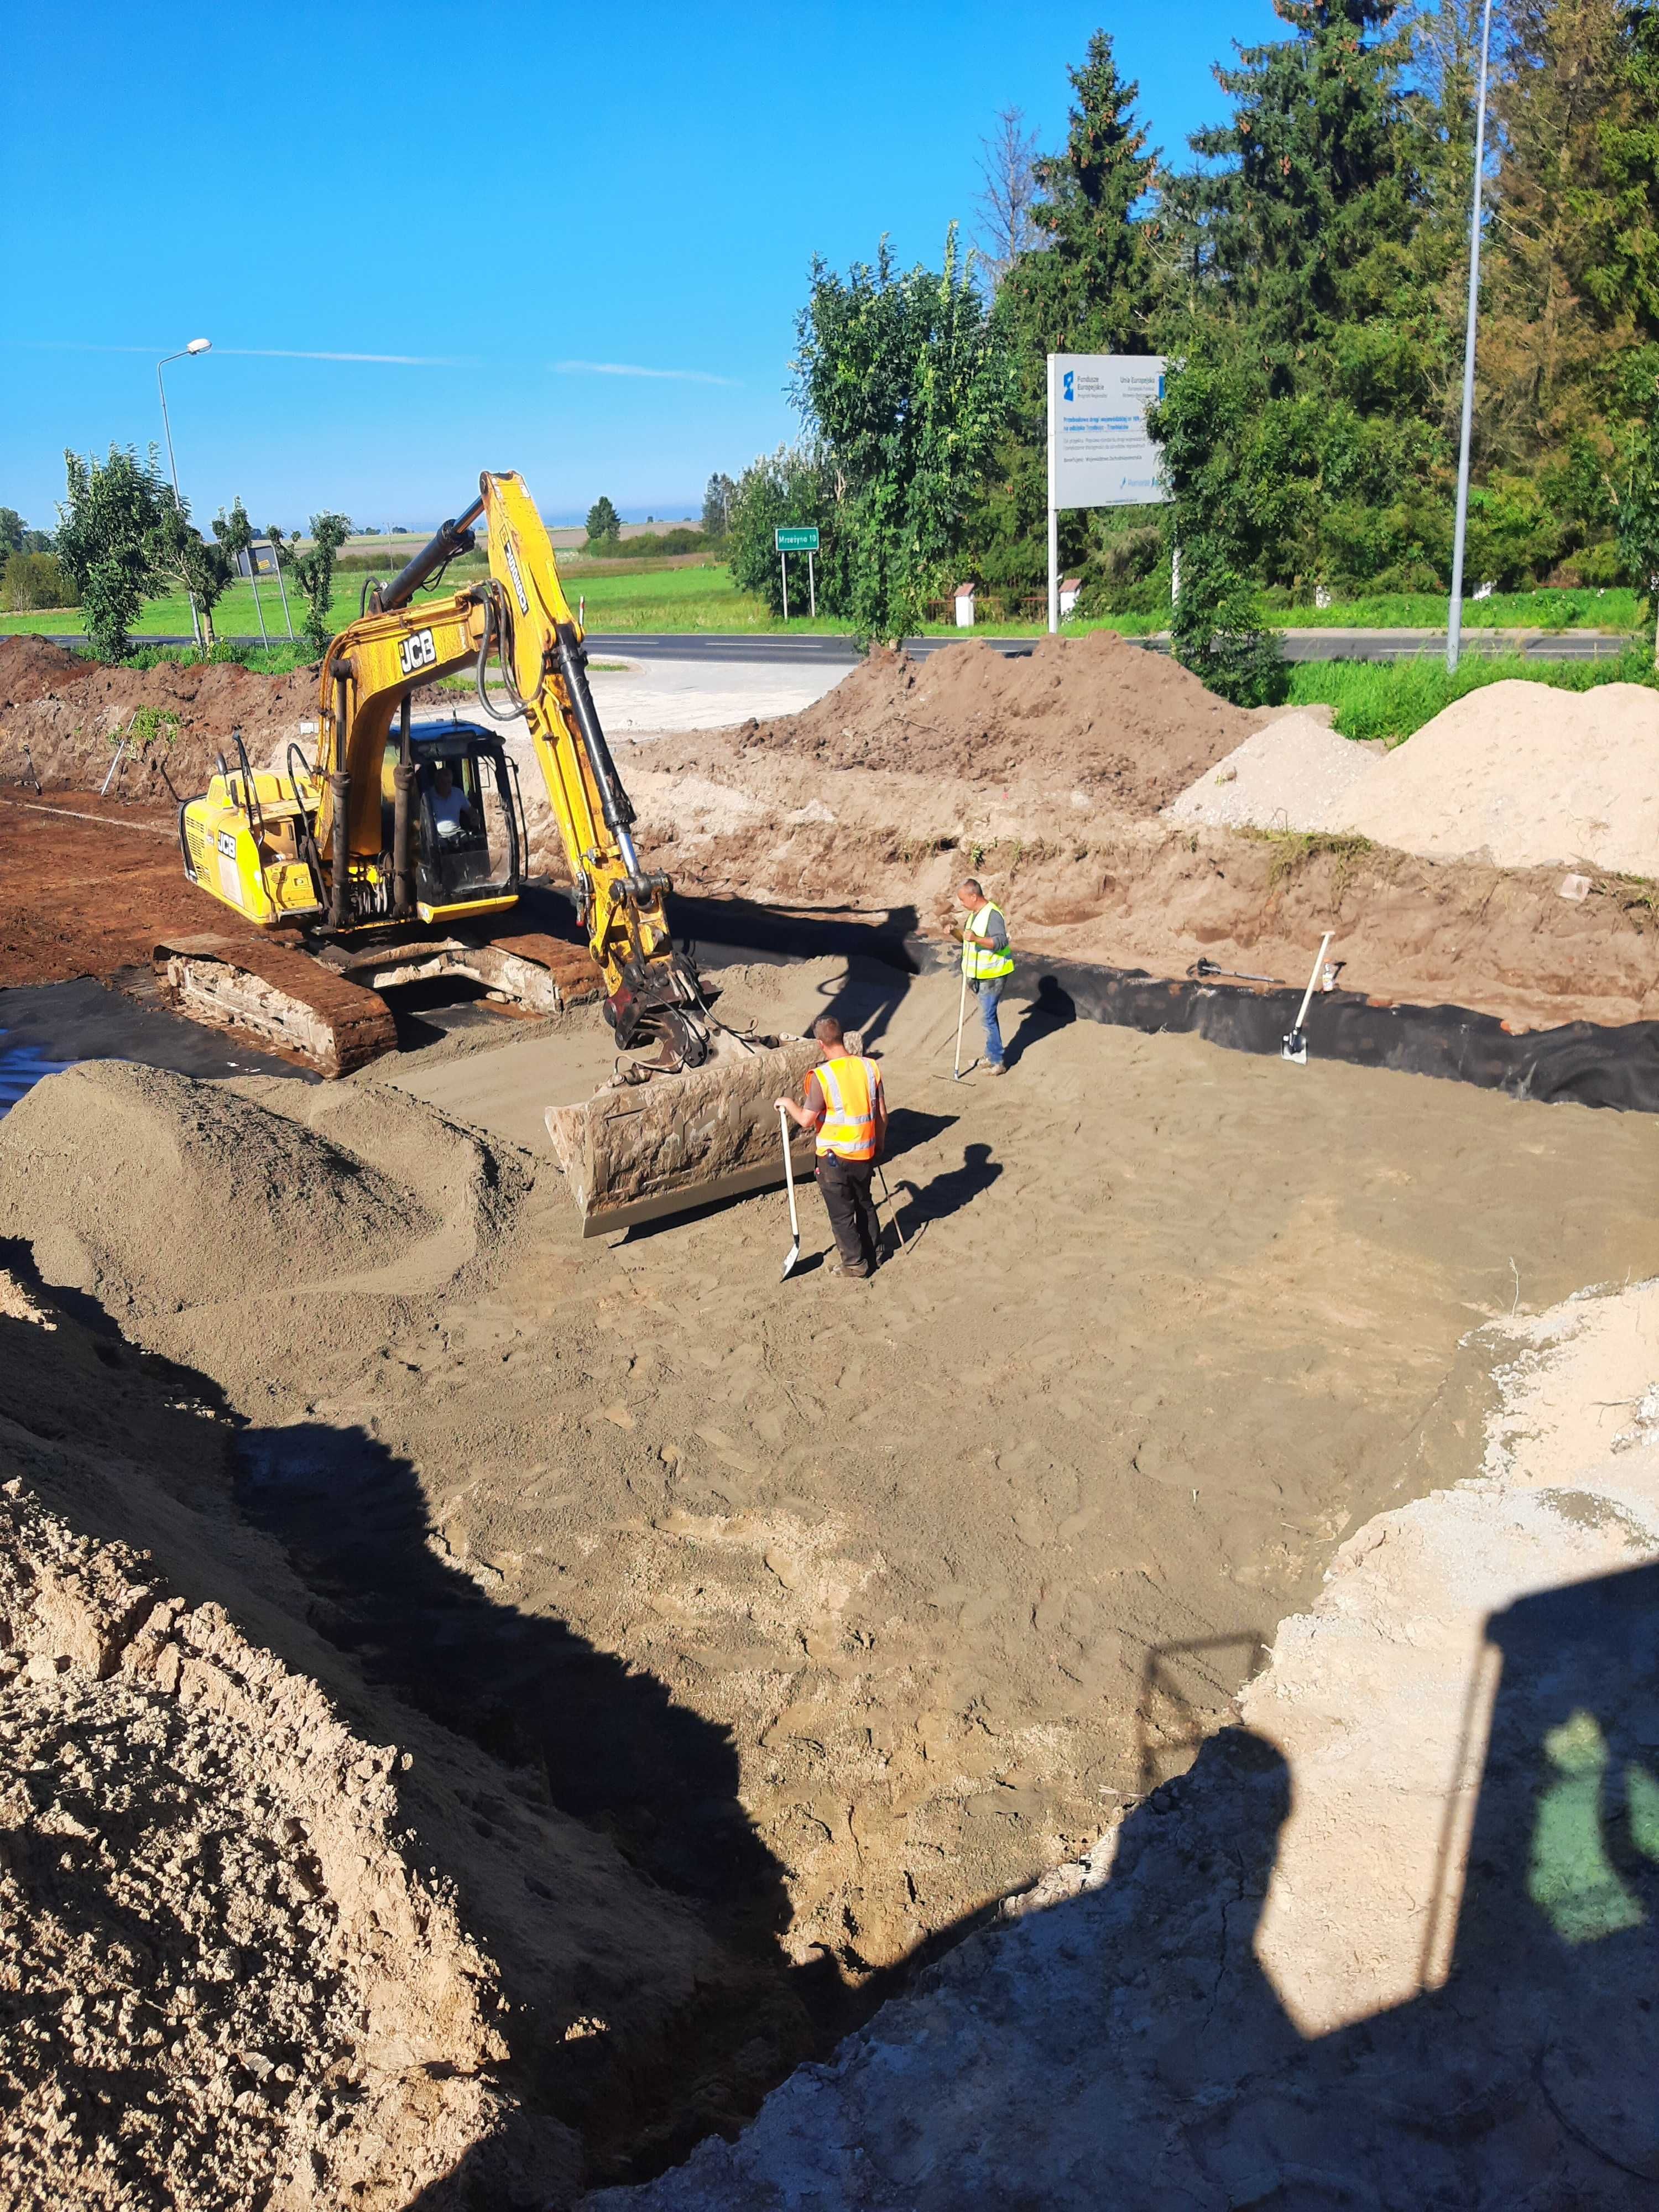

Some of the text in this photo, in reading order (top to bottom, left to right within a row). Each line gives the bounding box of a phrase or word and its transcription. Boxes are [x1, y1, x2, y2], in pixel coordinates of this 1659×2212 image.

[779, 535, 807, 545] Mrzeżyno
[401, 629, 436, 672] JCB
[218, 833, 236, 859] JCB
